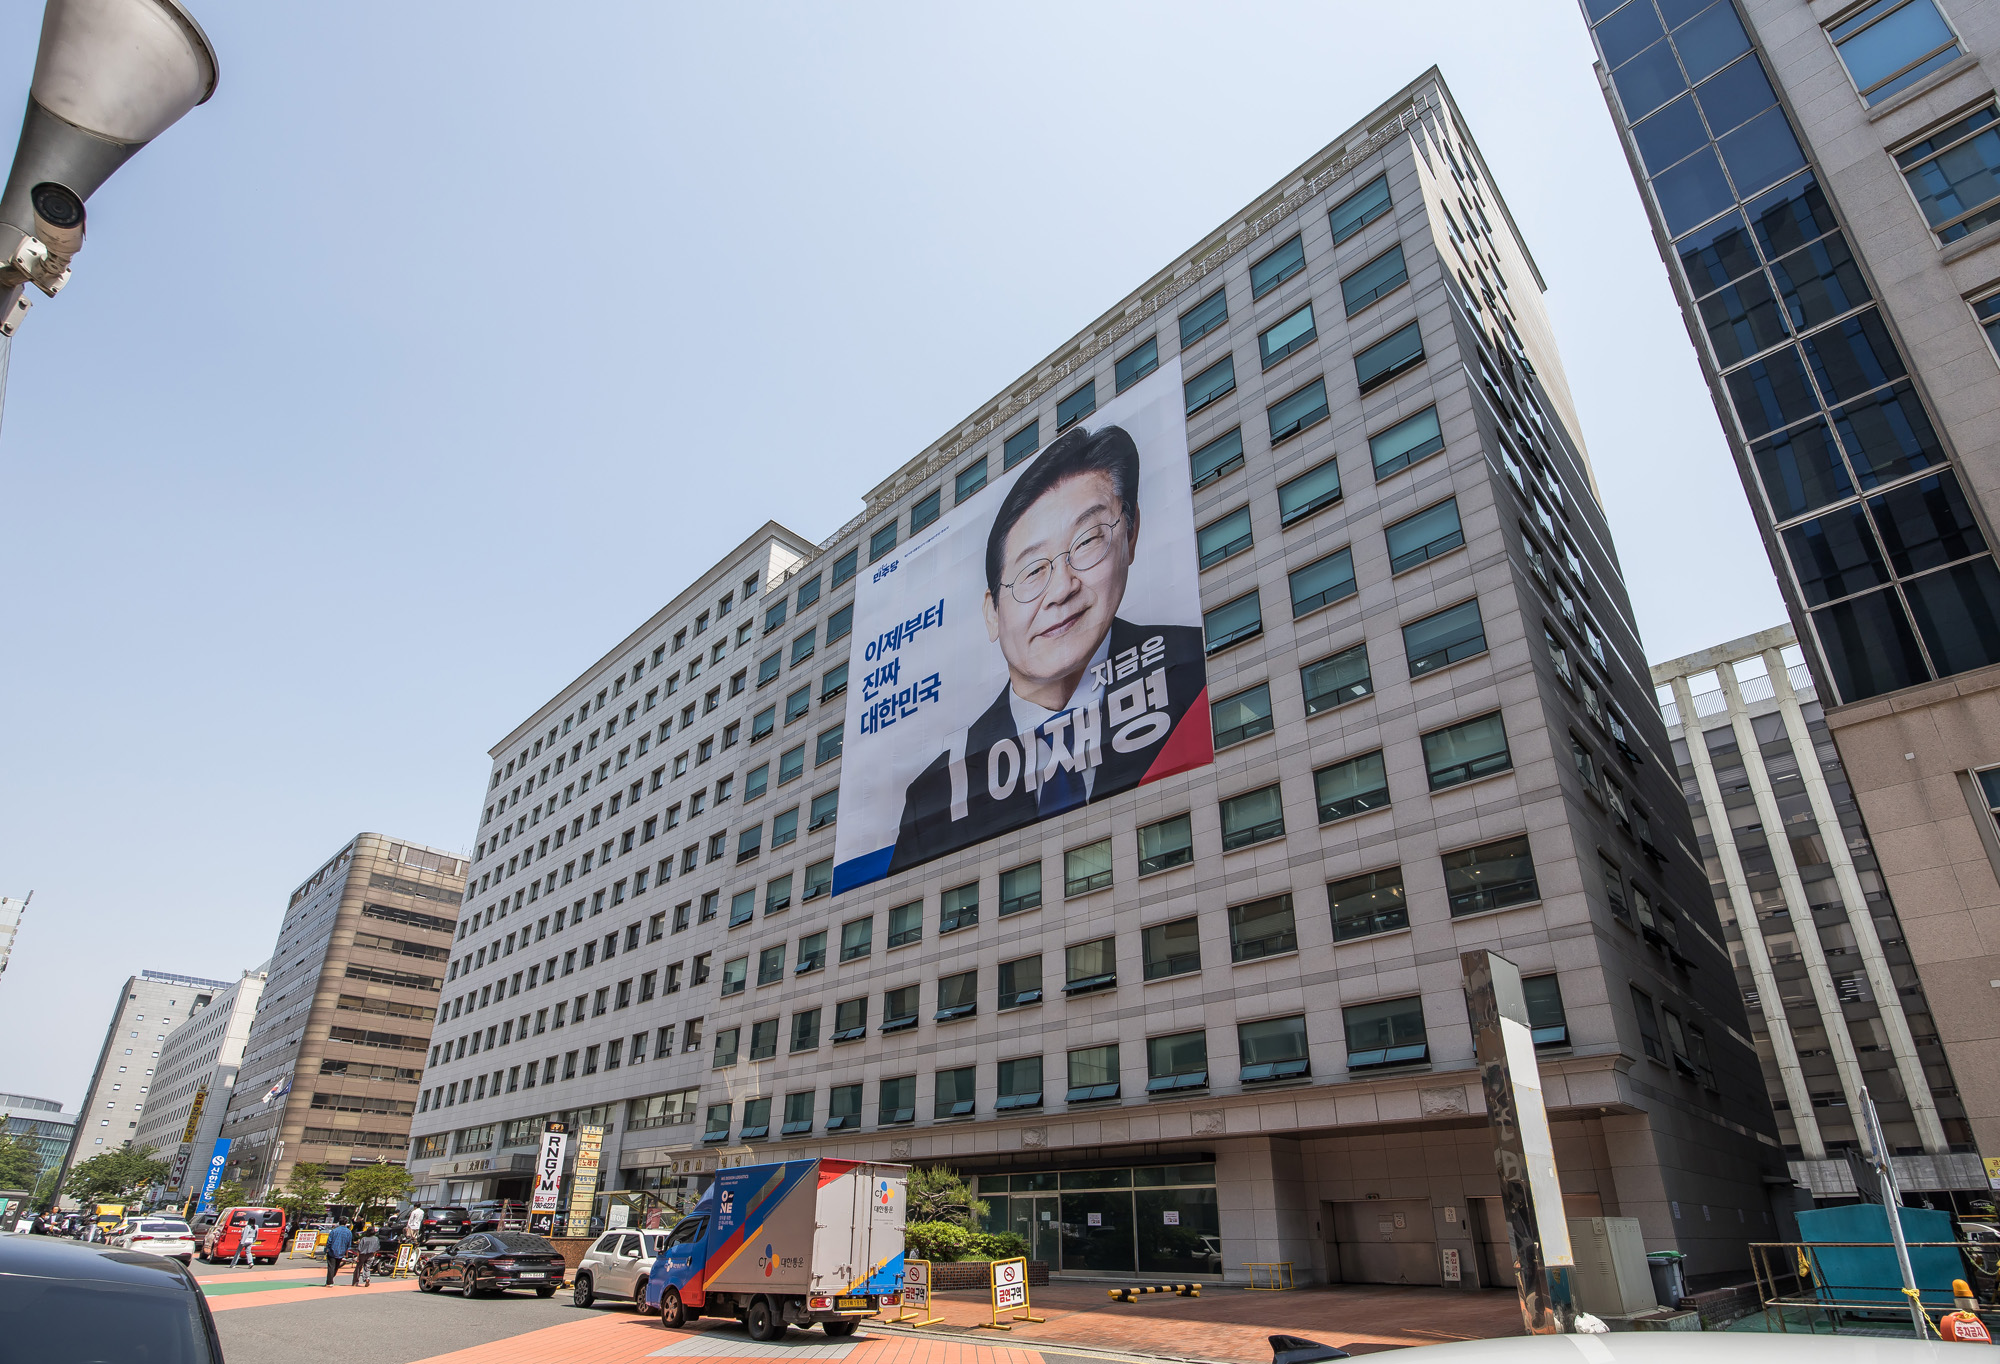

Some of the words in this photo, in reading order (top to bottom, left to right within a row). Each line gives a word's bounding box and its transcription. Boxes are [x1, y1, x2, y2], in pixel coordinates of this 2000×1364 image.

[873, 560, 899, 584] 민주당
[865, 598, 944, 661] 이제부터
[1090, 635, 1166, 692] 지금은
[862, 656, 900, 702] 진짜
[861, 672, 941, 734] 대한민국
[942, 726, 969, 822] 1
[987, 666, 1171, 800] 이재명
[541, 1136, 561, 1191] RNGYM
[204, 1167, 221, 1200] 신한은행
[874, 1189, 883, 1199] CJ
[873, 1205, 894, 1214] 대한통운
[758, 1257, 768, 1269] CJ
[781, 1256, 804, 1268] 대한통운
[905, 1286, 925, 1301] 금연구역
[999, 1286, 1022, 1303] 금연구역
[1956, 1326, 1984, 1338] 주차금지
